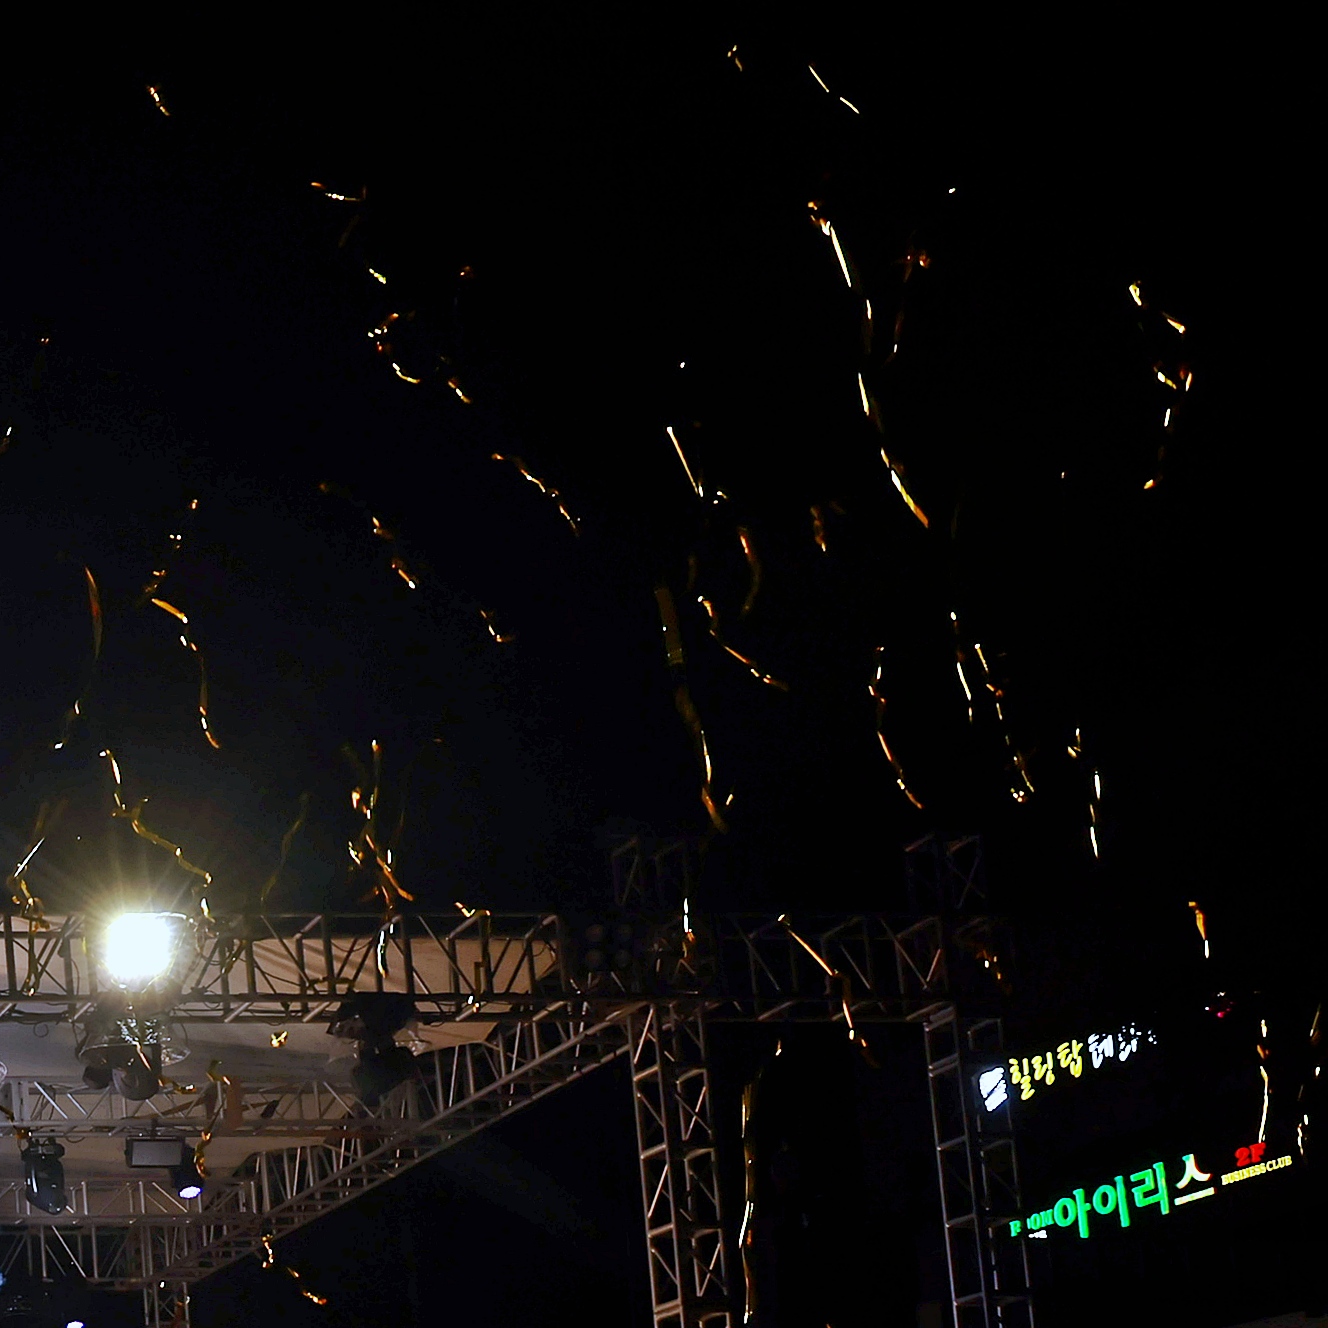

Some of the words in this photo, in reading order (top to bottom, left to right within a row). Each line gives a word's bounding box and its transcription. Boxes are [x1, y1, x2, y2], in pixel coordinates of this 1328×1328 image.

[1008, 1039, 1083, 1100] 힐링탑
[1234, 1142, 1266, 1167] 2F
[1266, 1155, 1292, 1172] CLUB
[1053, 1153, 1215, 1238] 아이리스
